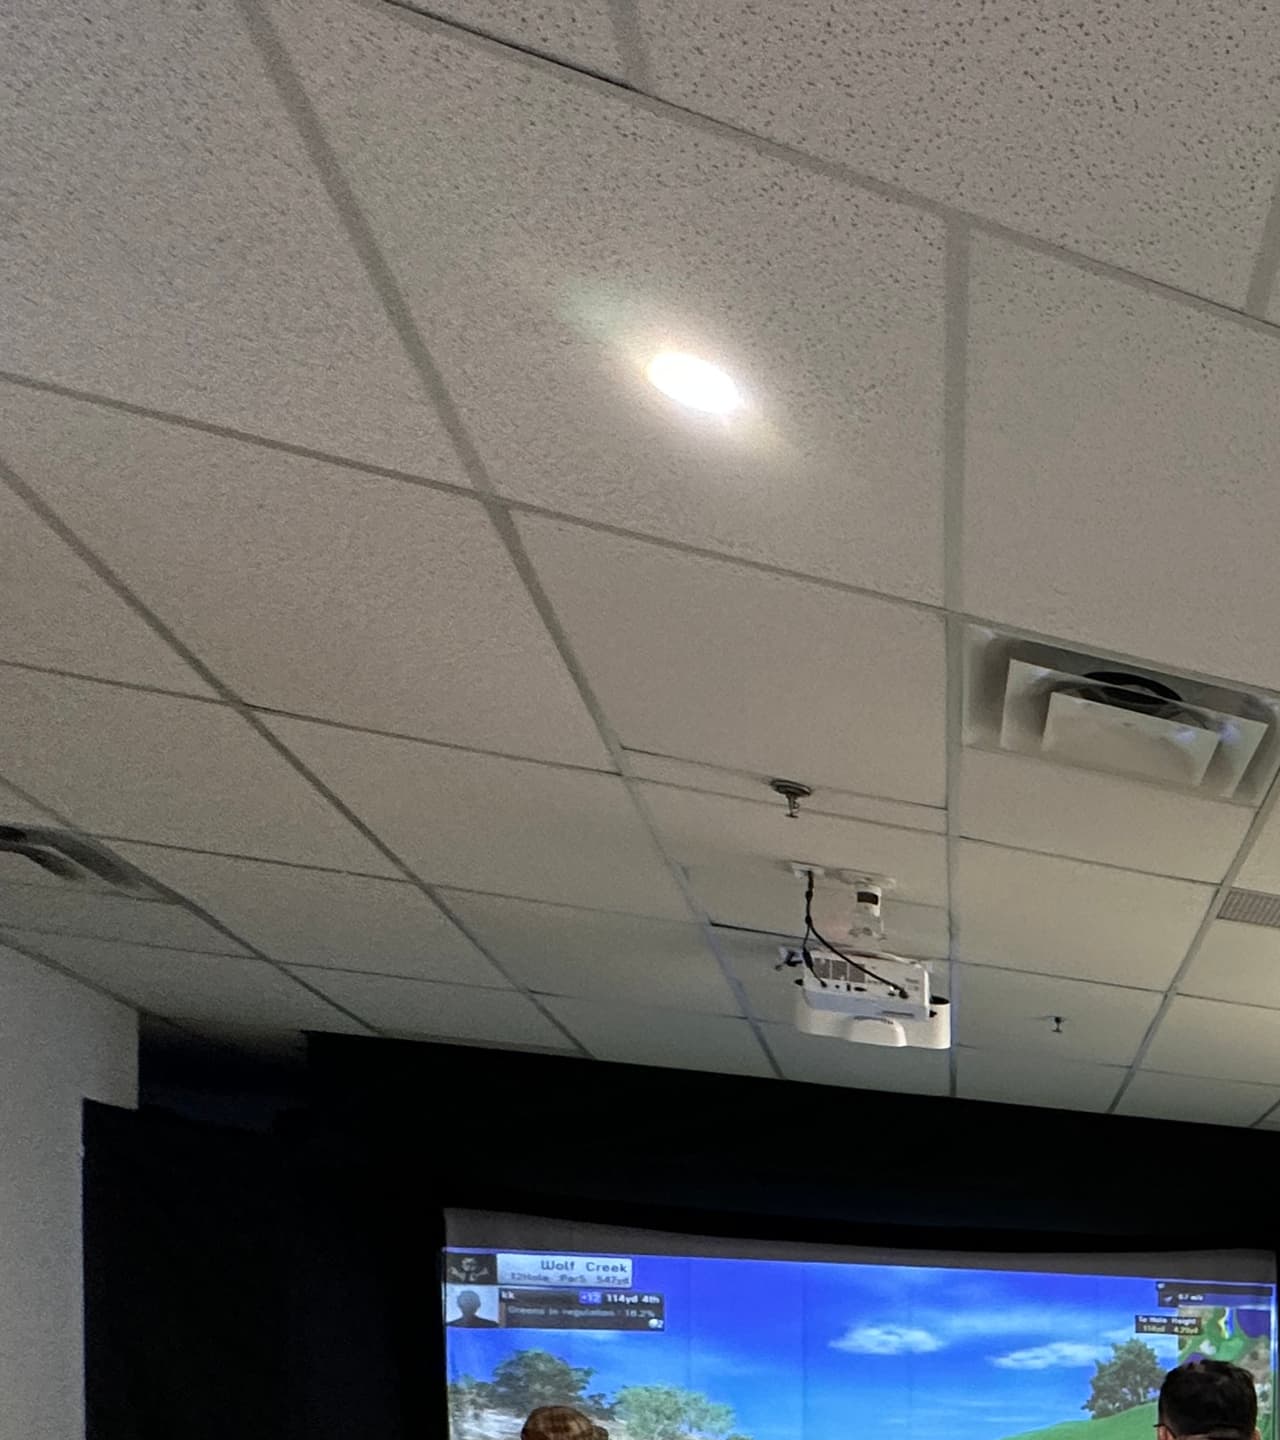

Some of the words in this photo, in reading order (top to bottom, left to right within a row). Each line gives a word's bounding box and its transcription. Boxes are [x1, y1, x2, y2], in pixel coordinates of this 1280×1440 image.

[541, 1260, 575, 1271] Wolf
[585, 1262, 628, 1273] Creek
[606, 1293, 638, 1304] 114yd
